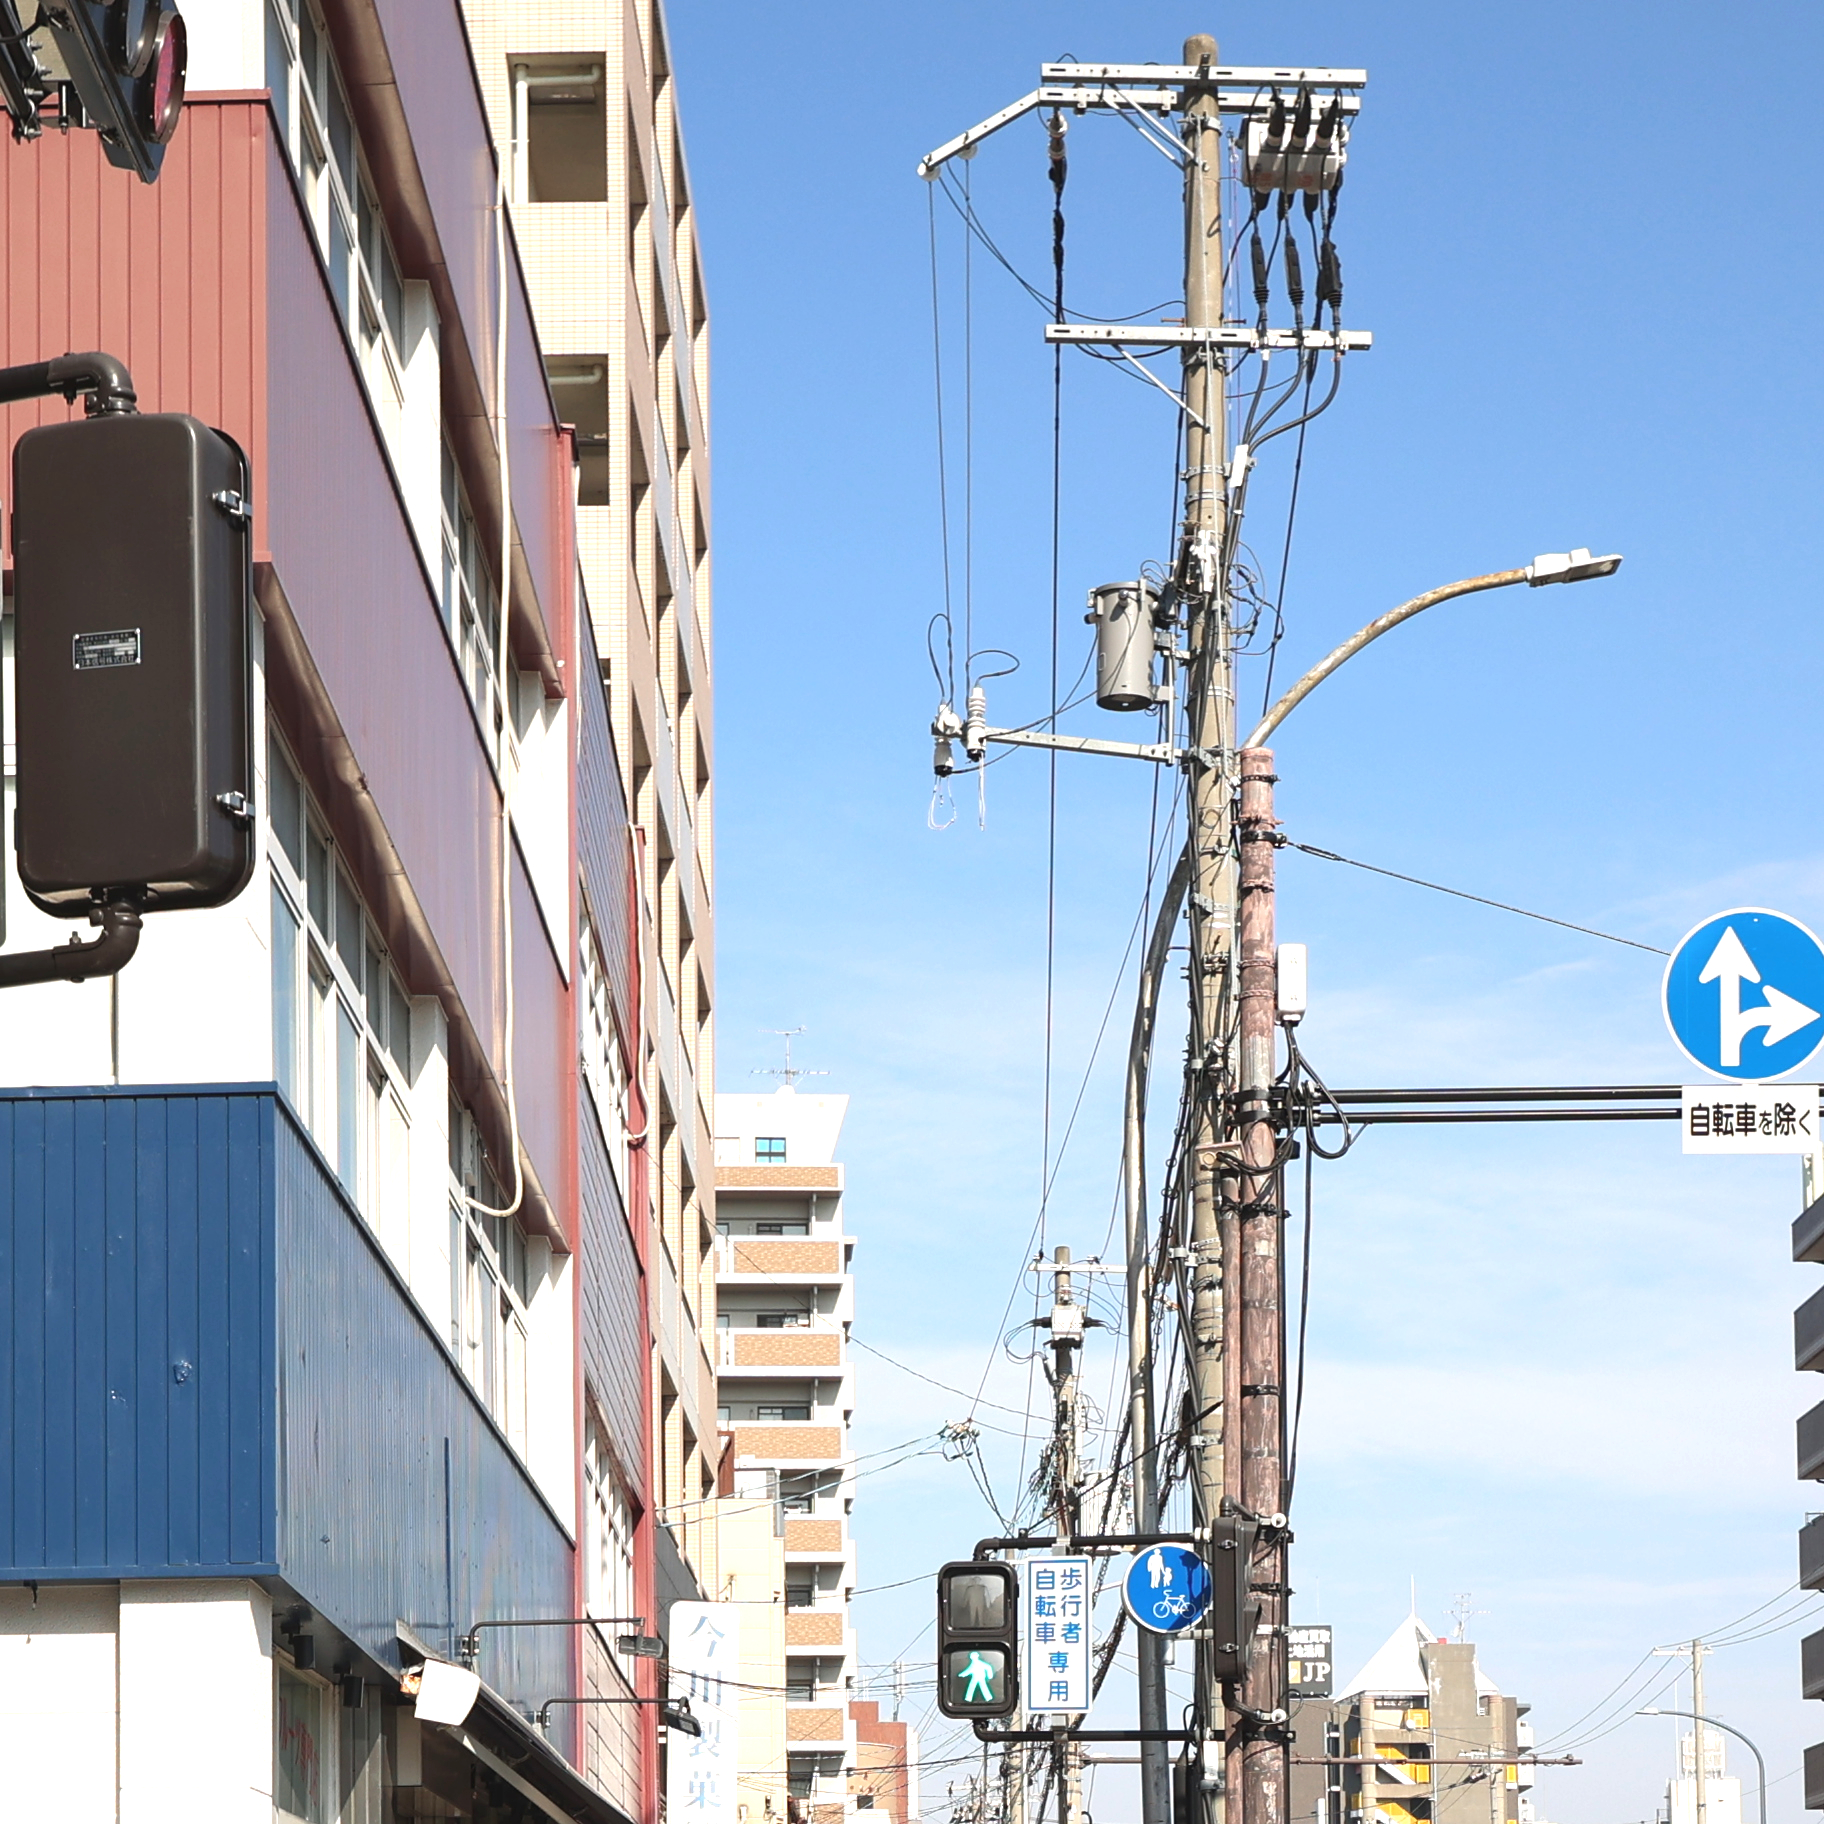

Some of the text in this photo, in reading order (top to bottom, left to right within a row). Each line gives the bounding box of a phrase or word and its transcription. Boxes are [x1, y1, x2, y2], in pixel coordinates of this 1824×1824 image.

[1689, 1102, 1812, 1139] 自転車を除く
[1035, 1568, 1056, 1644] 自転車
[1060, 1567, 1082, 1643] 歩行者
[1048, 1651, 1069, 1702] 専用
[1303, 1662, 1331, 1682] JP
